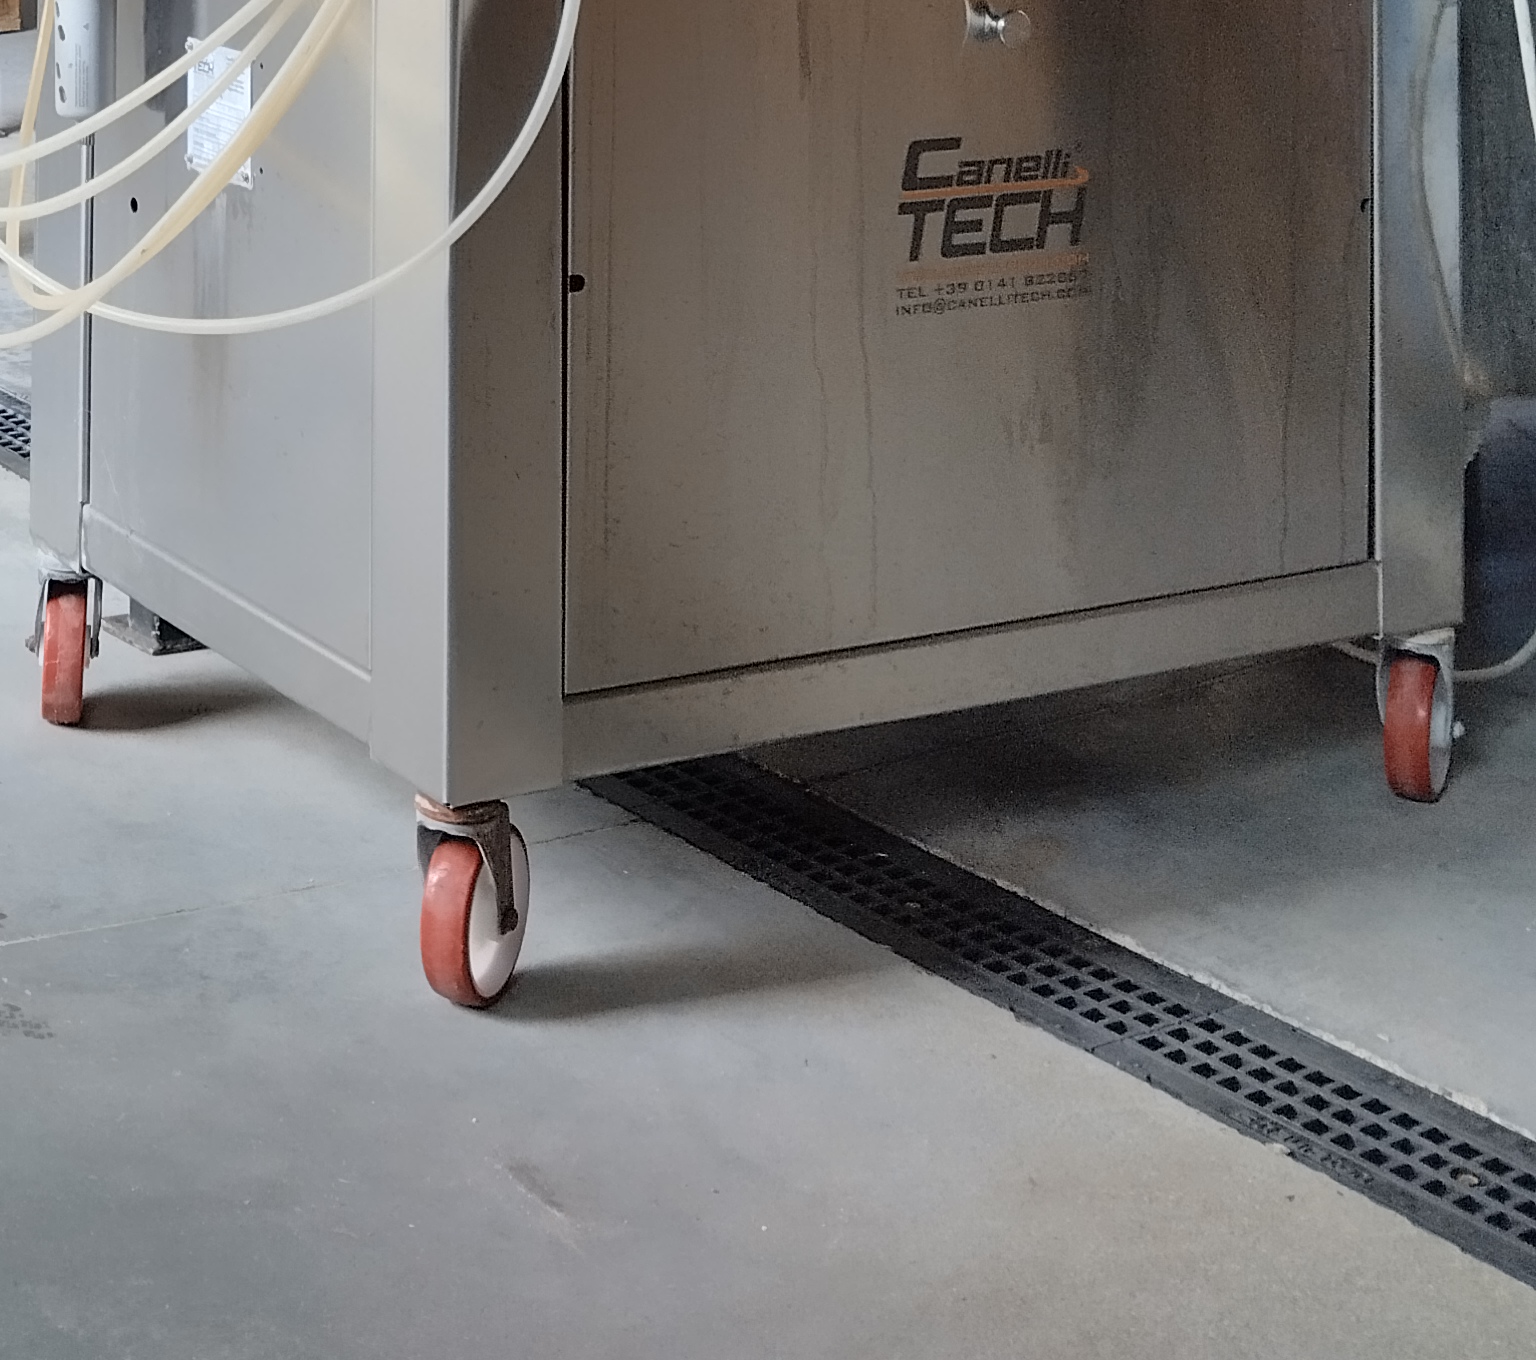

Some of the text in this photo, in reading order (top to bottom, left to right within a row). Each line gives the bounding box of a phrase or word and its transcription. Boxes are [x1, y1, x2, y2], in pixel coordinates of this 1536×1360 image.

[901, 137, 1071, 191] Canelli
[898, 186, 1087, 262] TECH
[896, 287, 927, 299] TEL
[934, 282, 967, 296] +39
[974, 277, 1015, 292] 0141
